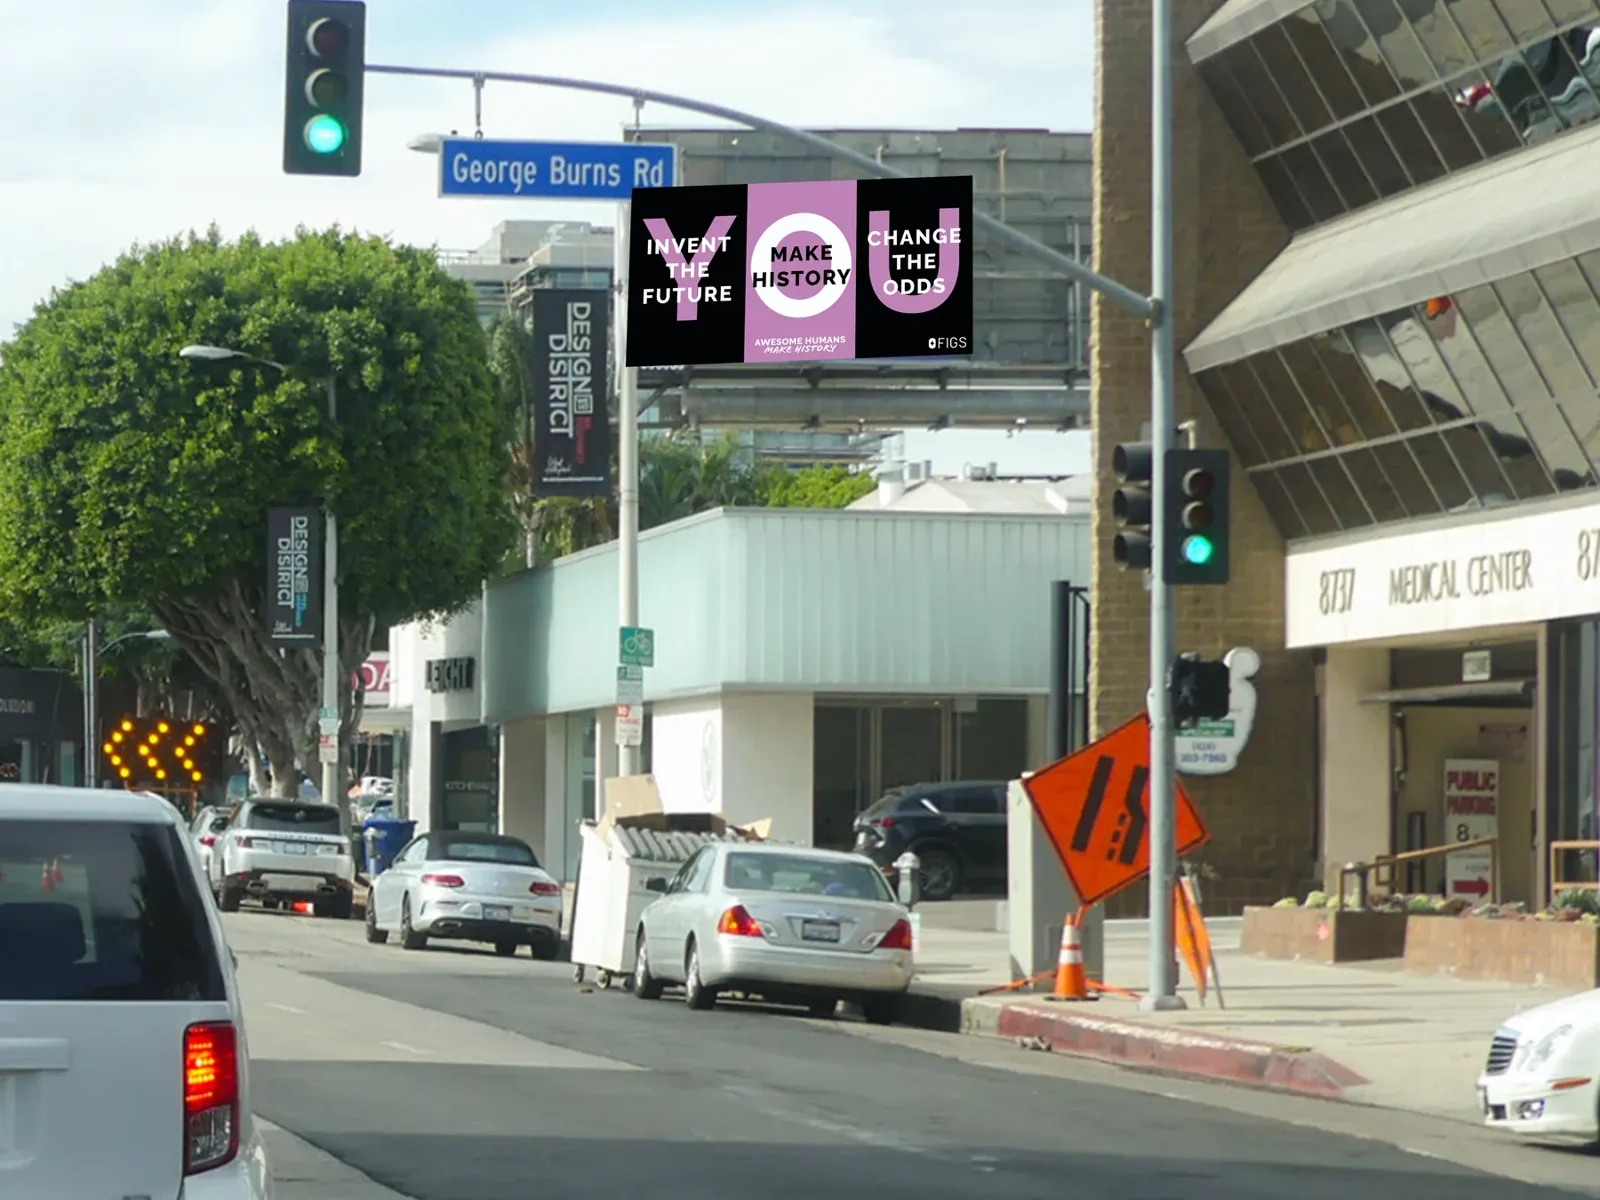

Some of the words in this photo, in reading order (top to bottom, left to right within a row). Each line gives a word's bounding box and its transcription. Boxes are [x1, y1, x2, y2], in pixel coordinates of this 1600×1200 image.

[452, 153, 537, 194] George
[550, 155, 621, 187] Burns
[633, 157, 664, 187] Rd
[646, 236, 732, 255] INVENT
[867, 227, 963, 247] CHANGE
[770, 244, 833, 263] MAKE
[892, 253, 937, 270] THE
[666, 261, 710, 279] THE
[752, 268, 852, 288] HISTORY
[642, 285, 732, 304] FUTURE
[883, 278, 946, 295] ODDS
[572, 302, 592, 394] DESIGN
[754, 337, 803, 347] AWESOME
[804, 335, 846, 345] HUMANS
[763, 345, 793, 354] MAKE
[794, 344, 837, 354] HISTORY
[937, 336, 967, 348] FIGS
[294, 516, 308, 579] DESIGN
[1388, 559, 1461, 606] MEDICAL
[1467, 549, 1534, 597] CENTER
[1319, 568, 1356, 616] 8737
[1447, 770, 1496, 792] PUBLIC
